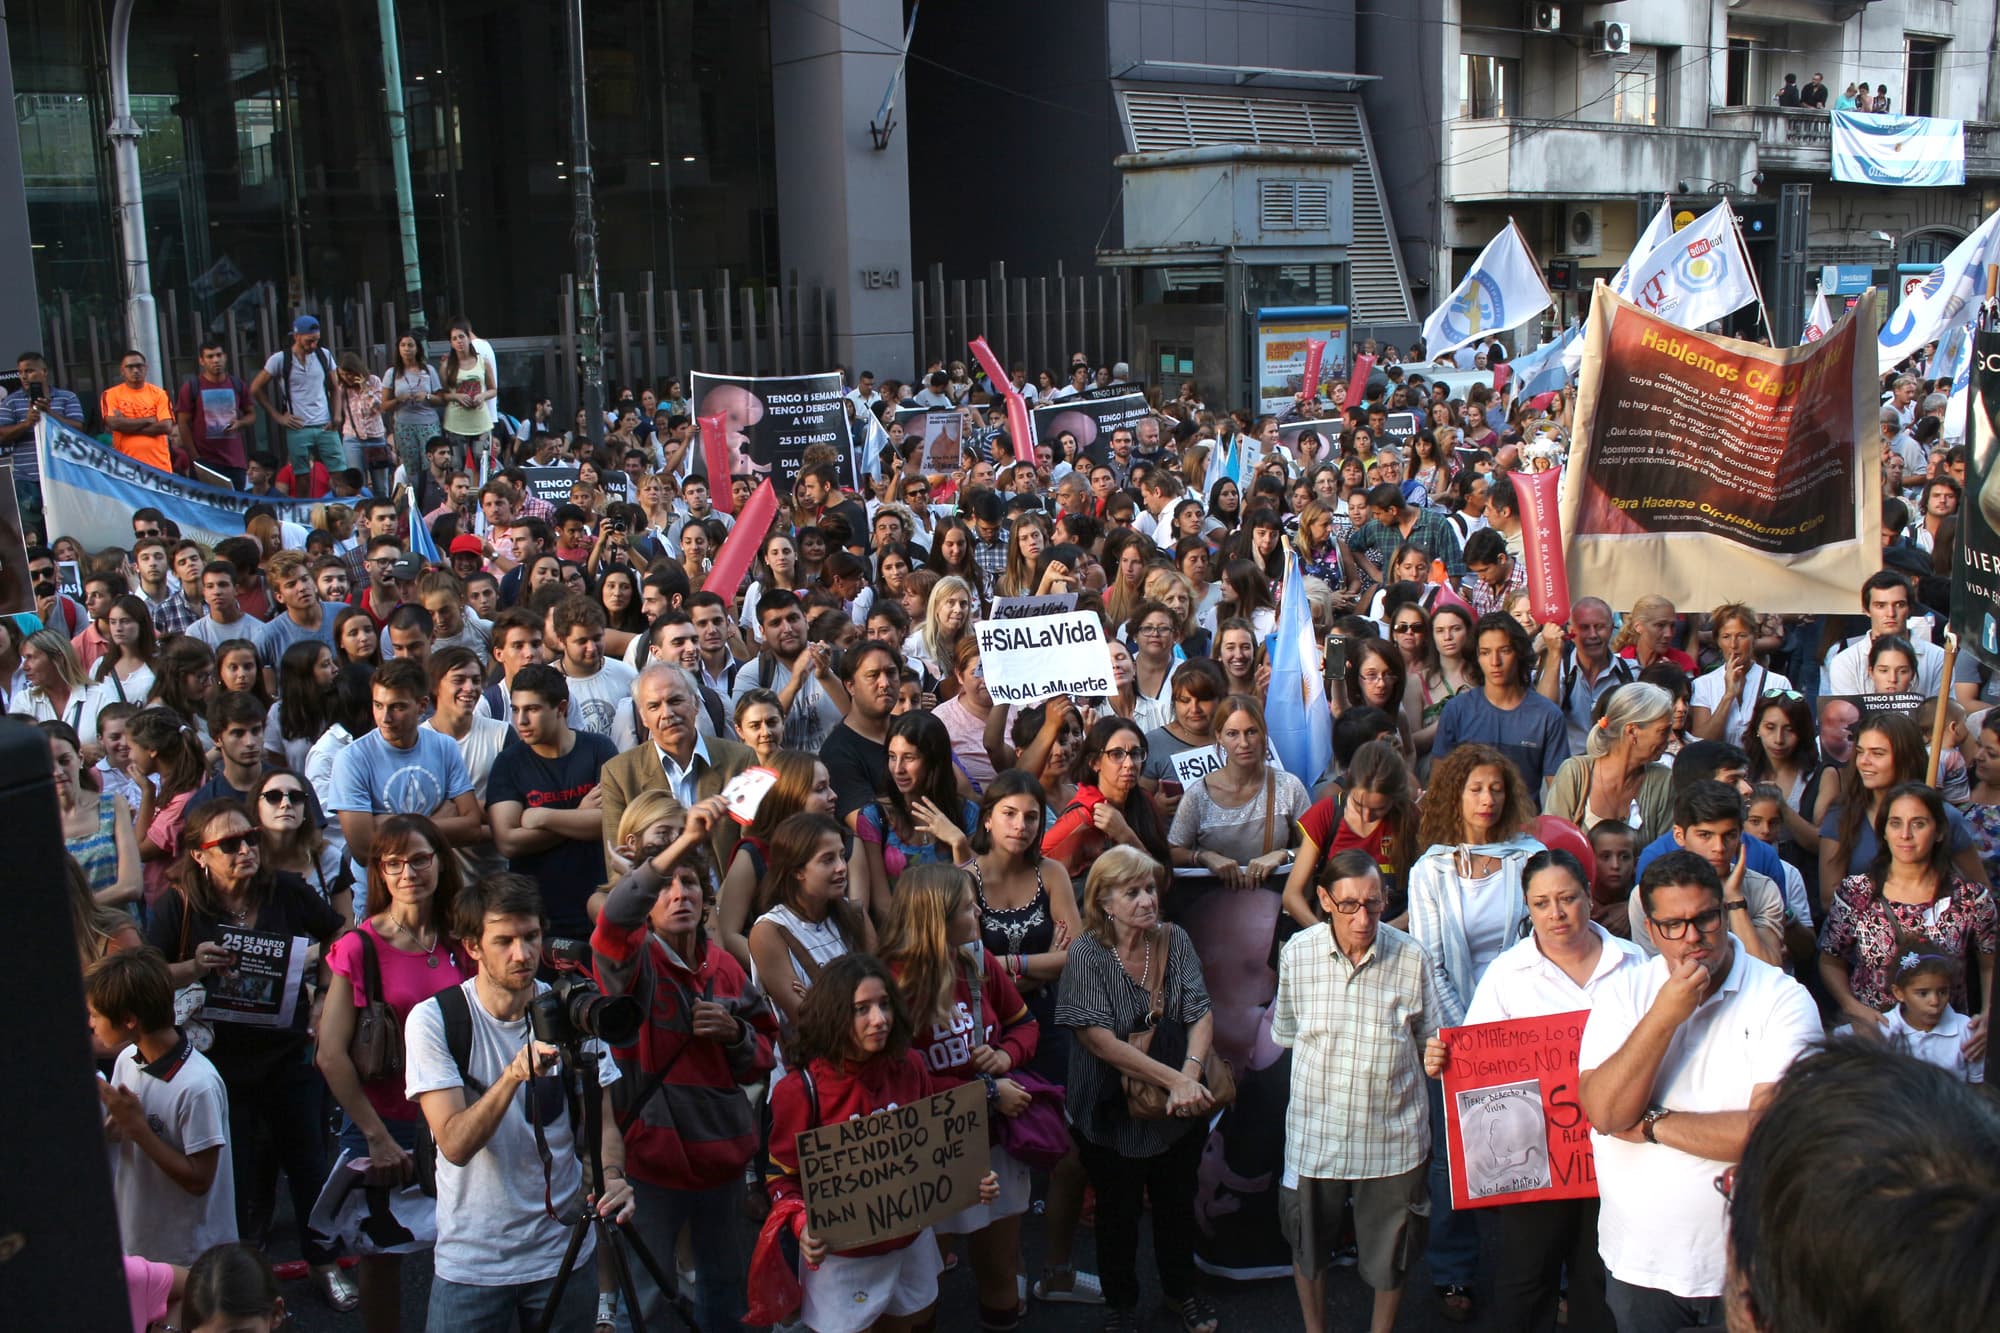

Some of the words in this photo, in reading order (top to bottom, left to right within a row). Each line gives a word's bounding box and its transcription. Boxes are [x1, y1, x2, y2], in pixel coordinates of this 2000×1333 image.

[862, 270, 900, 289] 1841
[1641, 328, 1738, 382] Hablemos
[1746, 369, 1796, 397] Claro
[1659, 372, 1700, 395] científica
[767, 393, 802, 404] TENGO
[803, 394, 809, 402] 8
[811, 390, 843, 401] SEMANAS
[769, 405, 804, 415] TENGO
[806, 402, 841, 413] DERECHO
[1629, 375, 1652, 387] cuya
[1654, 382, 1700, 404] existencia
[1701, 400, 1745, 422] comienza
[1719, 387, 1731, 396] El
[1733, 391, 1754, 406] niño
[1755, 403, 1774, 413] por
[793, 418, 801, 426] A
[803, 415, 824, 425] VIVIR
[1098, 412, 1121, 424] TENGO
[1618, 399, 1631, 409] No
[1632, 401, 1650, 411] hay
[1651, 404, 1672, 416] acto
[1673, 409, 1686, 421] de
[1687, 416, 1717, 432] mayor
[1718, 427, 1784, 456] discriminación
[779, 436, 791, 445] 25
[793, 435, 807, 445] DE
[808, 432, 837, 444] MARZO
[1669, 418, 1687, 429] que
[1689, 425, 1721, 441] decidir
[1721, 438, 1745, 456] quien
[1746, 451, 1771, 463] nace
[781, 458, 800, 468] DIA
[1601, 445, 1646, 455] Apostemos
[1647, 447, 1654, 455] a
[1655, 446, 1664, 455] la
[1665, 448, 1685, 458] vida
[1693, 456, 1732, 478] pidamos
[1628, 428, 1652, 437] culpa
[1654, 430, 1683, 443] tienen
[1684, 438, 1698, 448] los
[1699, 444, 1724, 460] niños
[1724, 456, 1777, 480] condenado
[534, 479, 573, 489] TENGO
[1598, 455, 1621, 466] social
[1628, 456, 1676, 467] económica
[1677, 460, 1698, 473] para
[1700, 466, 1709, 476] la
[1709, 472, 1737, 490] madre
[1746, 488, 1755, 496] el
[1756, 491, 1777, 503] niño
[1534, 485, 1542, 498] LA
[1536, 498, 1545, 522] VIDA
[1610, 496, 1639, 511] Para
[1641, 496, 1696, 510] Hacerse
[1699, 503, 1796, 537] Oír-Hablemos
[1799, 514, 1825, 533] Claro
[1543, 562, 1551, 574] LA
[1545, 575, 1553, 598] VIDA
[1966, 581, 1990, 599] VIDA
[982, 620, 1097, 652] #SiALaVida
[991, 677, 1108, 701] #NoALaMuerte
[1863, 695, 1888, 703] TENGO
[221, 933, 243, 951] 25
[243, 935, 256, 945] DE
[256, 937, 286, 949] MARZO
[242, 944, 284, 958] 2018
[1450, 1031, 1473, 1052] NO
[1476, 1027, 1540, 1049] MATEMOS
[1534, 1045, 1562, 1072] NO
[1549, 1083, 1583, 1129] S
[798, 1130, 832, 1158] EL
[840, 1105, 919, 1147] ABORTO
[930, 1090, 956, 1118] ES
[804, 1127, 929, 1179] DEFENDIDO
[943, 1110, 980, 1143] POR
[808, 1153, 919, 1204] PERSONAS
[866, 1174, 953, 1237] NACIDO
